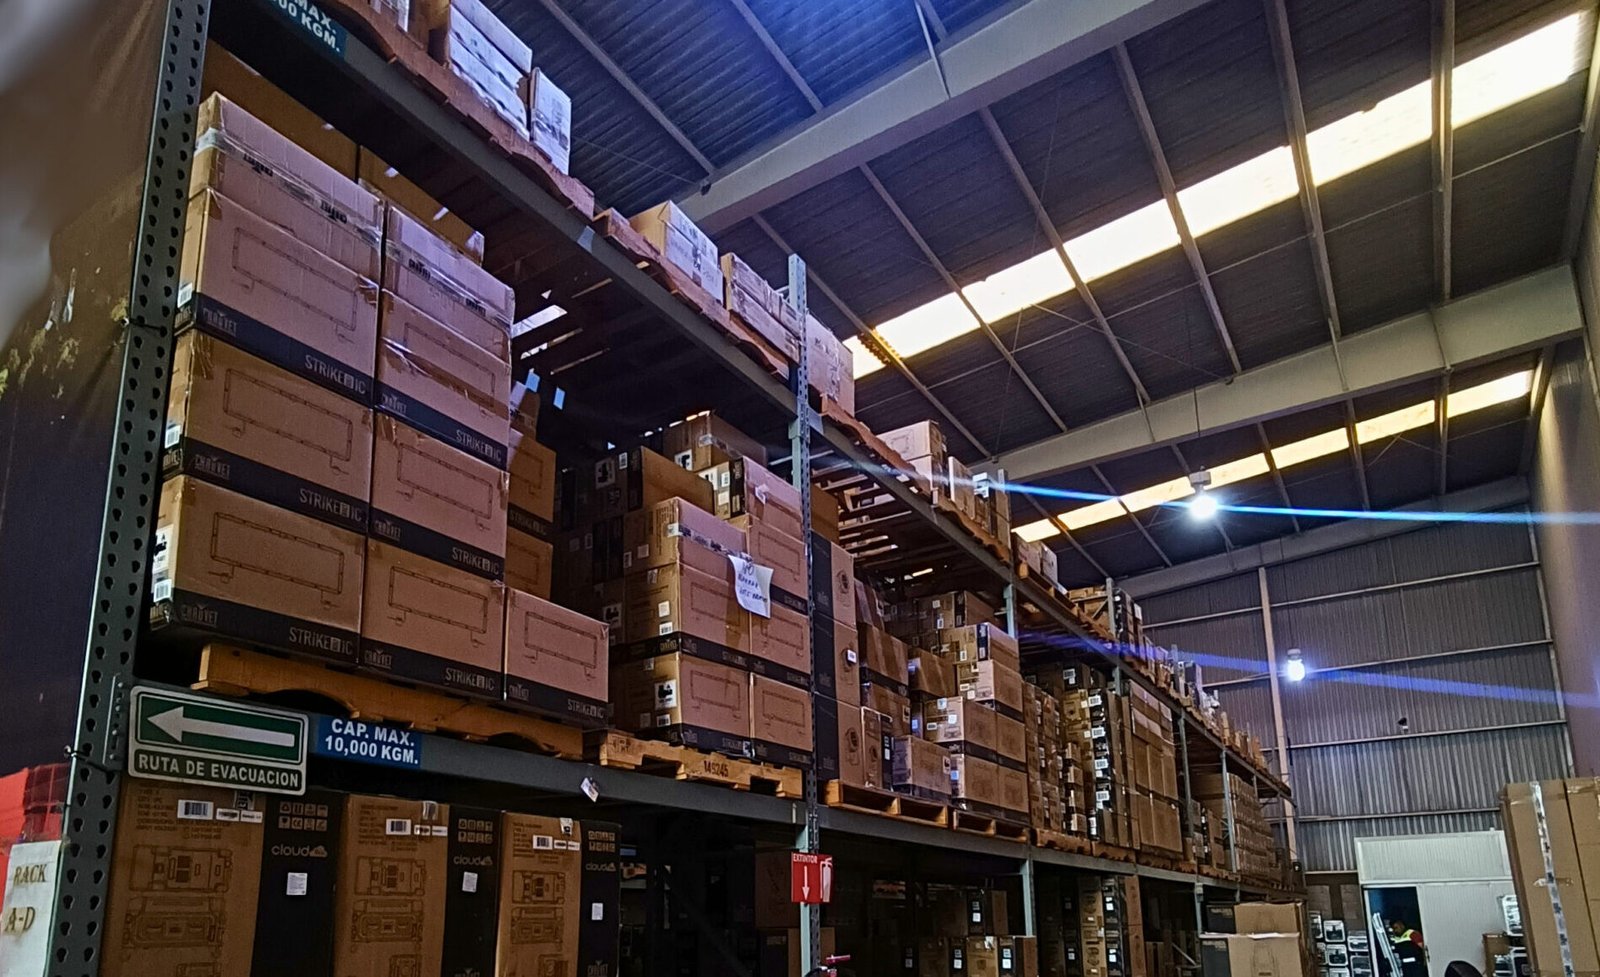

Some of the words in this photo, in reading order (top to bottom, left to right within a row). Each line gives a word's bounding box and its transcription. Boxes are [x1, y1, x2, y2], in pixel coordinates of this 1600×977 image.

[301, 12, 340, 52] KGM.
[331, 718, 369, 739] CAP.
[374, 726, 415, 747] MAX.
[325, 735, 378, 758] 10,000
[381, 744, 419, 765] KGM.
[138, 753, 180, 774] RUTA
[186, 760, 205, 778] DE
[211, 763, 299, 788] EVACUACION
[271, 844, 310, 857] cloud
[453, 855, 483, 866] cloud
[793, 853, 818, 864] EXTINTOR
[14, 864, 47, 887] RACK
[4, 906, 36, 934] A-D
